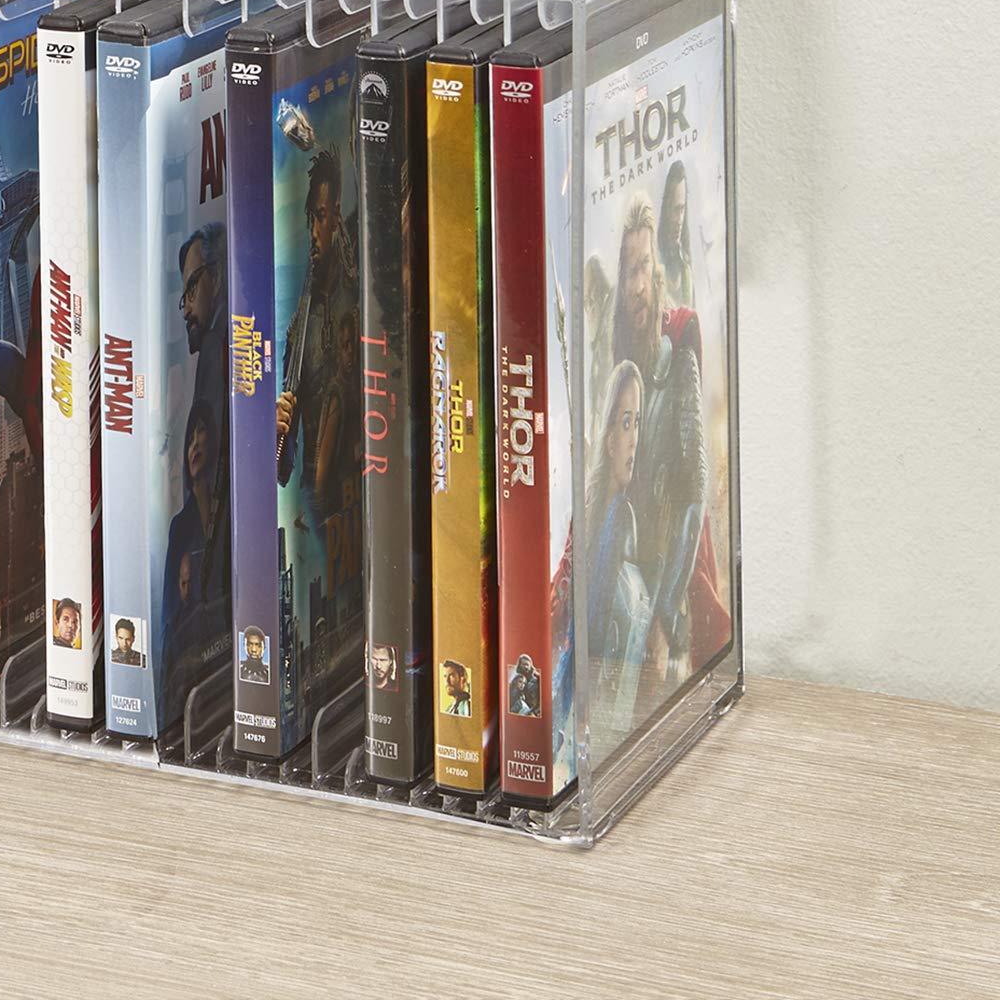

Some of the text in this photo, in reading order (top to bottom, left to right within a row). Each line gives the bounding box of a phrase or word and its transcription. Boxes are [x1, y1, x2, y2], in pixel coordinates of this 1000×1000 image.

[46, 43, 74, 53] DVD
[636, 32, 648, 49] DVD
[106, 56, 141, 67] DVD
[232, 63, 261, 74] DVD
[432, 79, 463, 90] DVD
[501, 80, 533, 91] DVD
[360, 119, 390, 130] DVD
[595, 84, 691, 179] THOR
[591, 129, 698, 204] THE DARK WORLD
[50, 259, 72, 353] ANT-MAN
[232, 312, 255, 397] PANTHER
[252, 331, 262, 381] BLACK
[51, 355, 73, 419] WASP
[105, 333, 133, 435] ANT-MAN
[360, 332, 389, 476] THOR
[431, 331, 447, 494] RAGNAROK
[450, 380, 464, 454] THOR
[509, 355, 534, 486] THOR
[68, 681, 89, 693] STUDIOS
[111, 695, 141, 712] MARVEL
[235, 711, 276, 729] MARVEL STUDIOS
[365, 736, 398, 759] MARVEL
[436, 744, 479, 763] MARVEL STUDIOS
[513, 750, 540, 761] 119557
[507, 760, 546, 782] MARVEL
